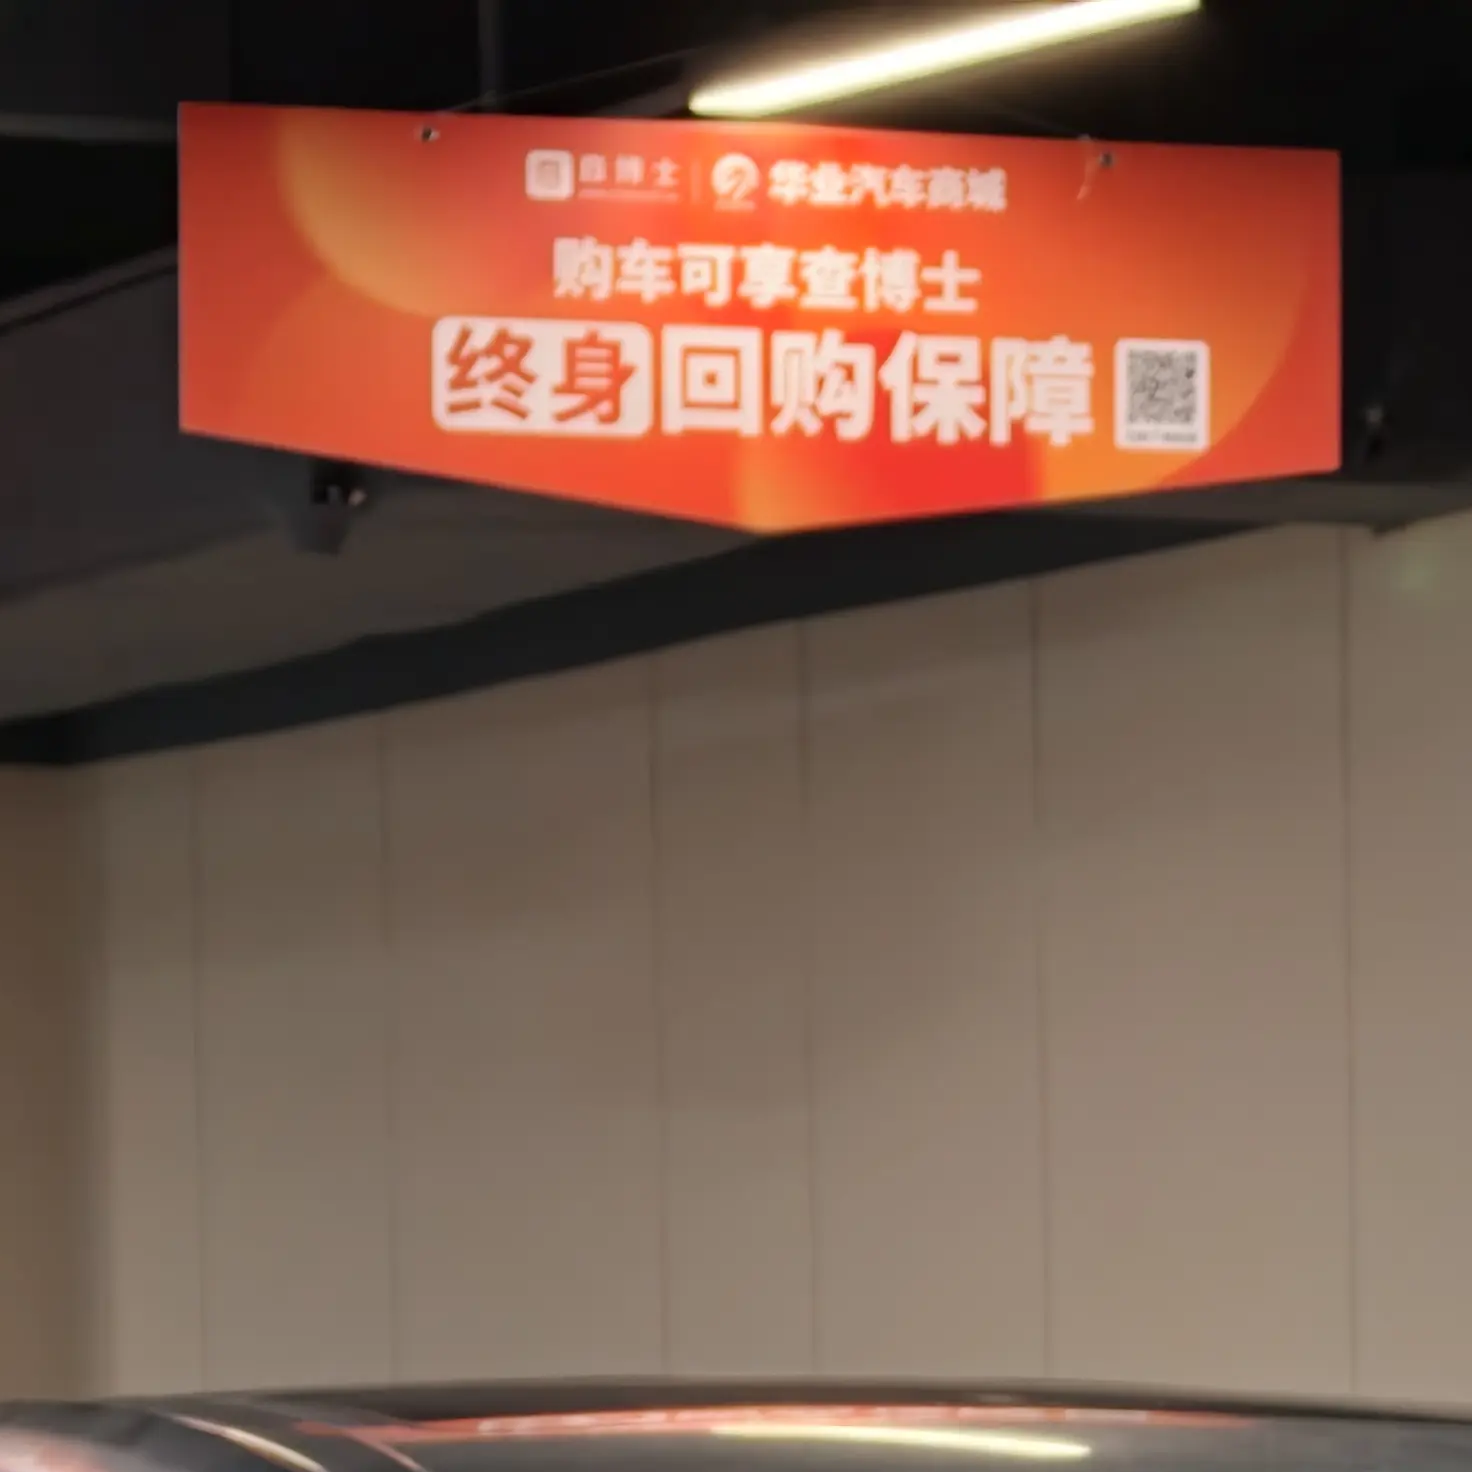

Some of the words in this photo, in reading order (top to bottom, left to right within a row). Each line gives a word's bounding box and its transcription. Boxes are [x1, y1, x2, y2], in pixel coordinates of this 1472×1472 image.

[552, 234, 983, 313] 购车可享查博士
[445, 320, 1096, 447] 终身回购保障
